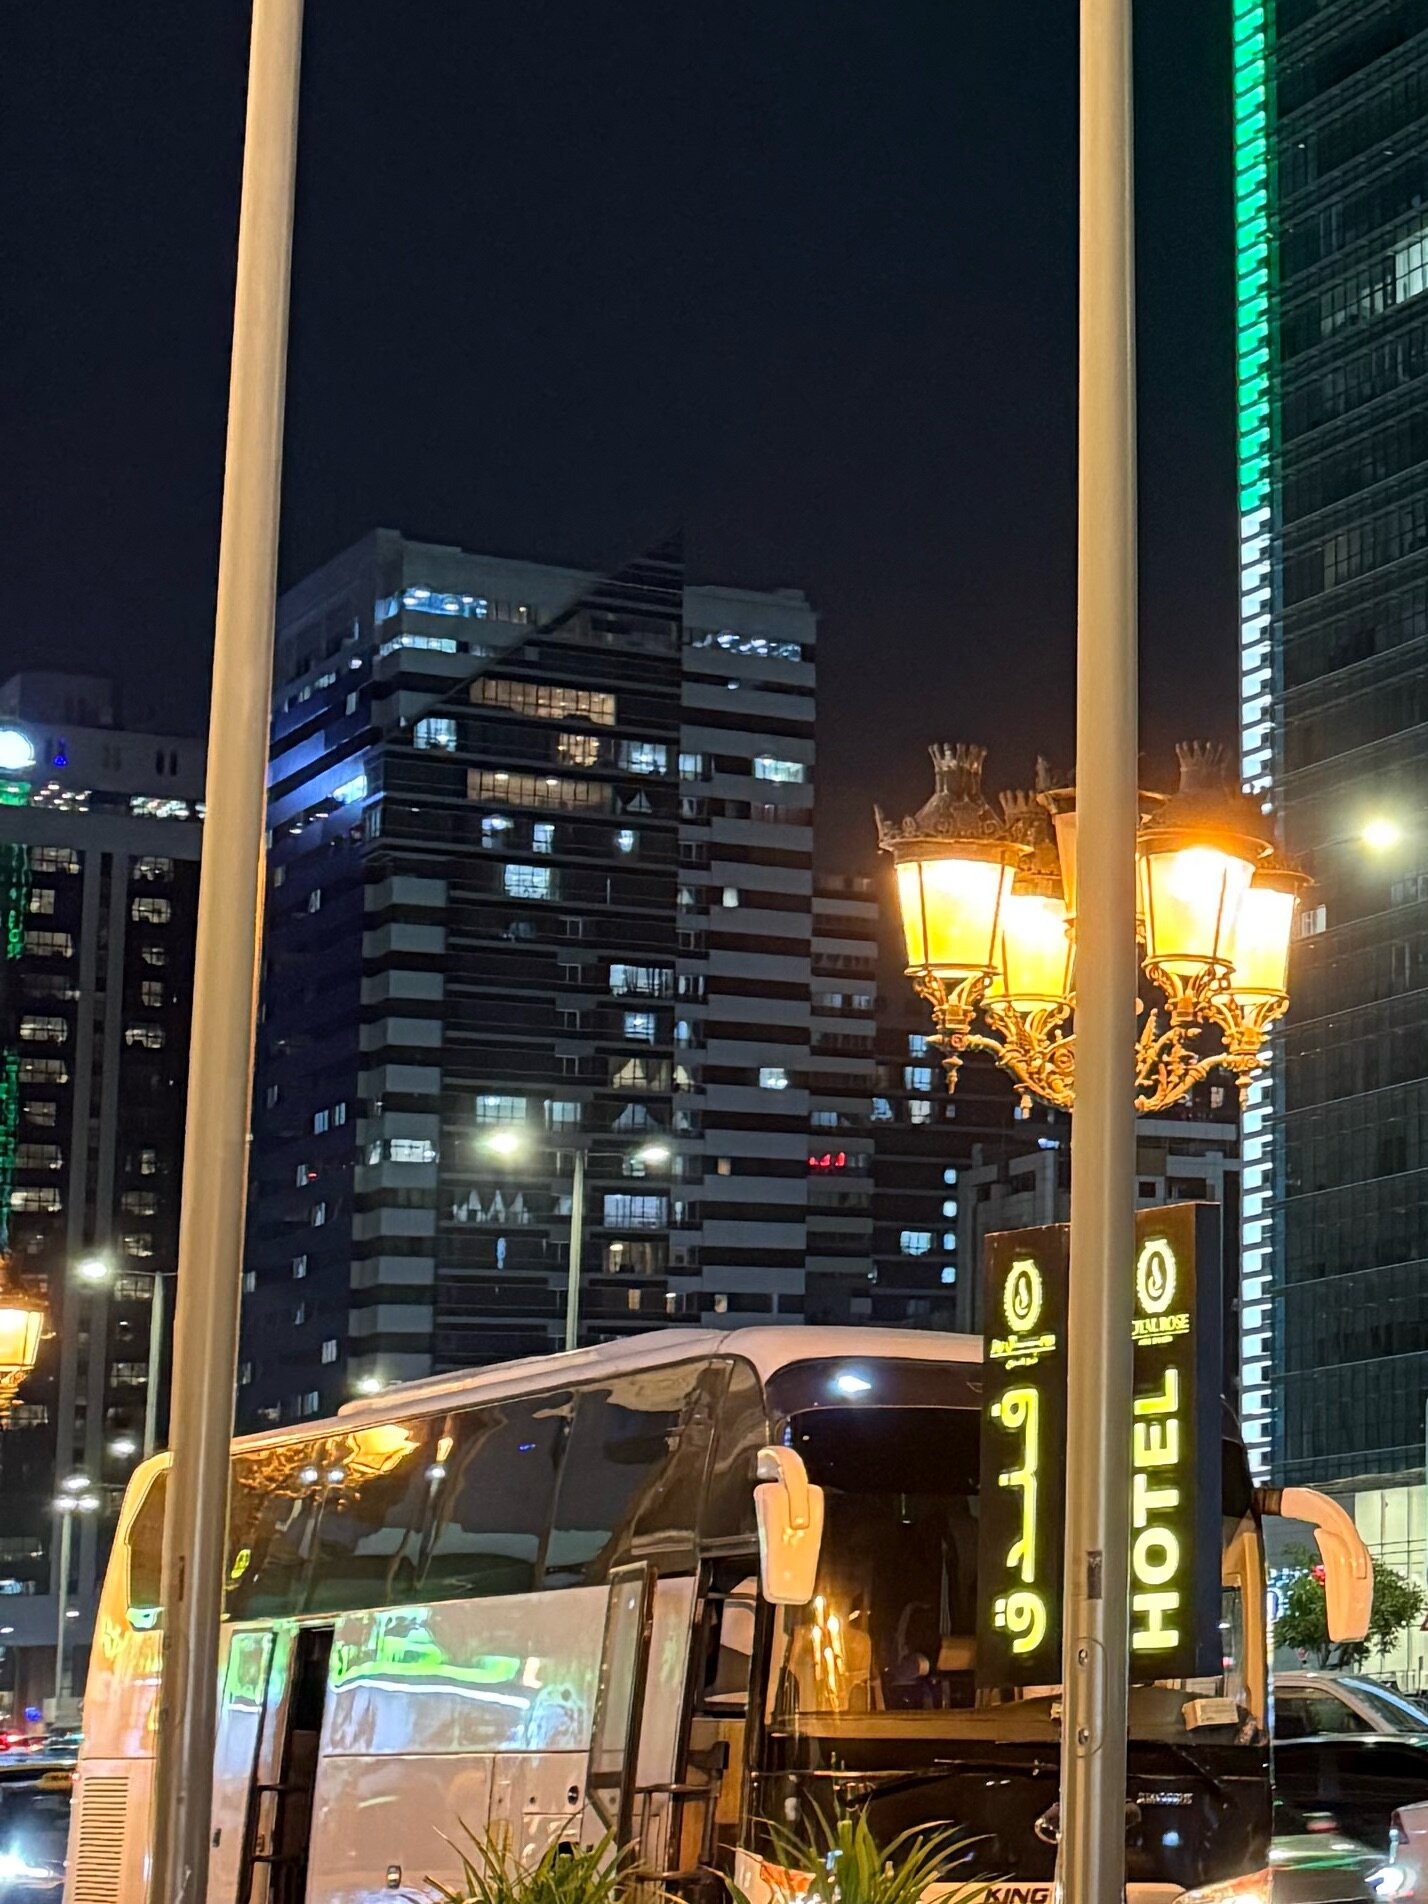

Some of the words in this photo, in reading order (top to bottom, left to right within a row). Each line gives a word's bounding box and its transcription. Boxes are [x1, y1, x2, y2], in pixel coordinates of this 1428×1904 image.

[991, 1387, 1047, 1654] فندق
[1132, 1367, 1179, 1649] HOTEL
[984, 1886, 1049, 1904] KING
